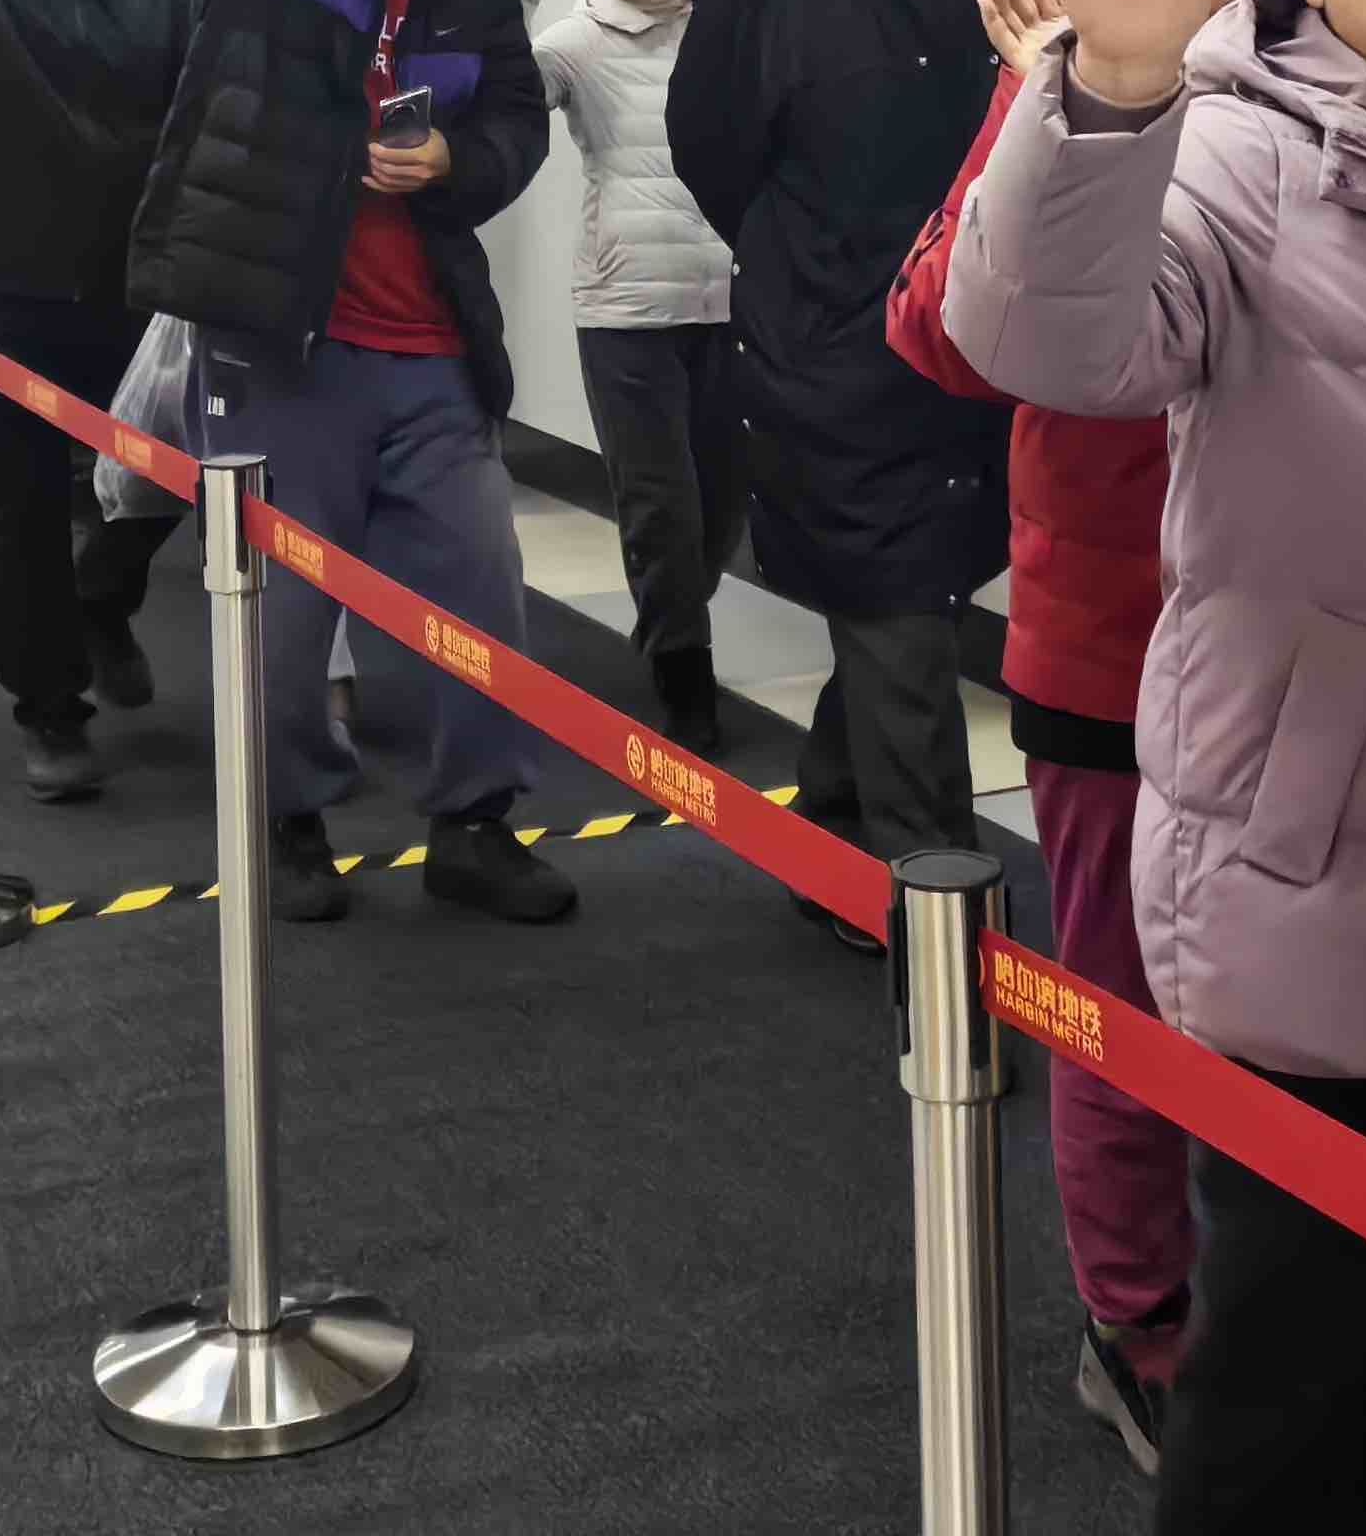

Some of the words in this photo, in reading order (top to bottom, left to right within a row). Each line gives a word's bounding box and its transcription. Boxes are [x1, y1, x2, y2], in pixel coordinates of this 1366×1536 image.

[994, 950, 1103, 1041] 哈尔滨地铁
[995, 986, 1050, 1033] HARBIN
[1051, 1018, 1104, 1062] METRO
